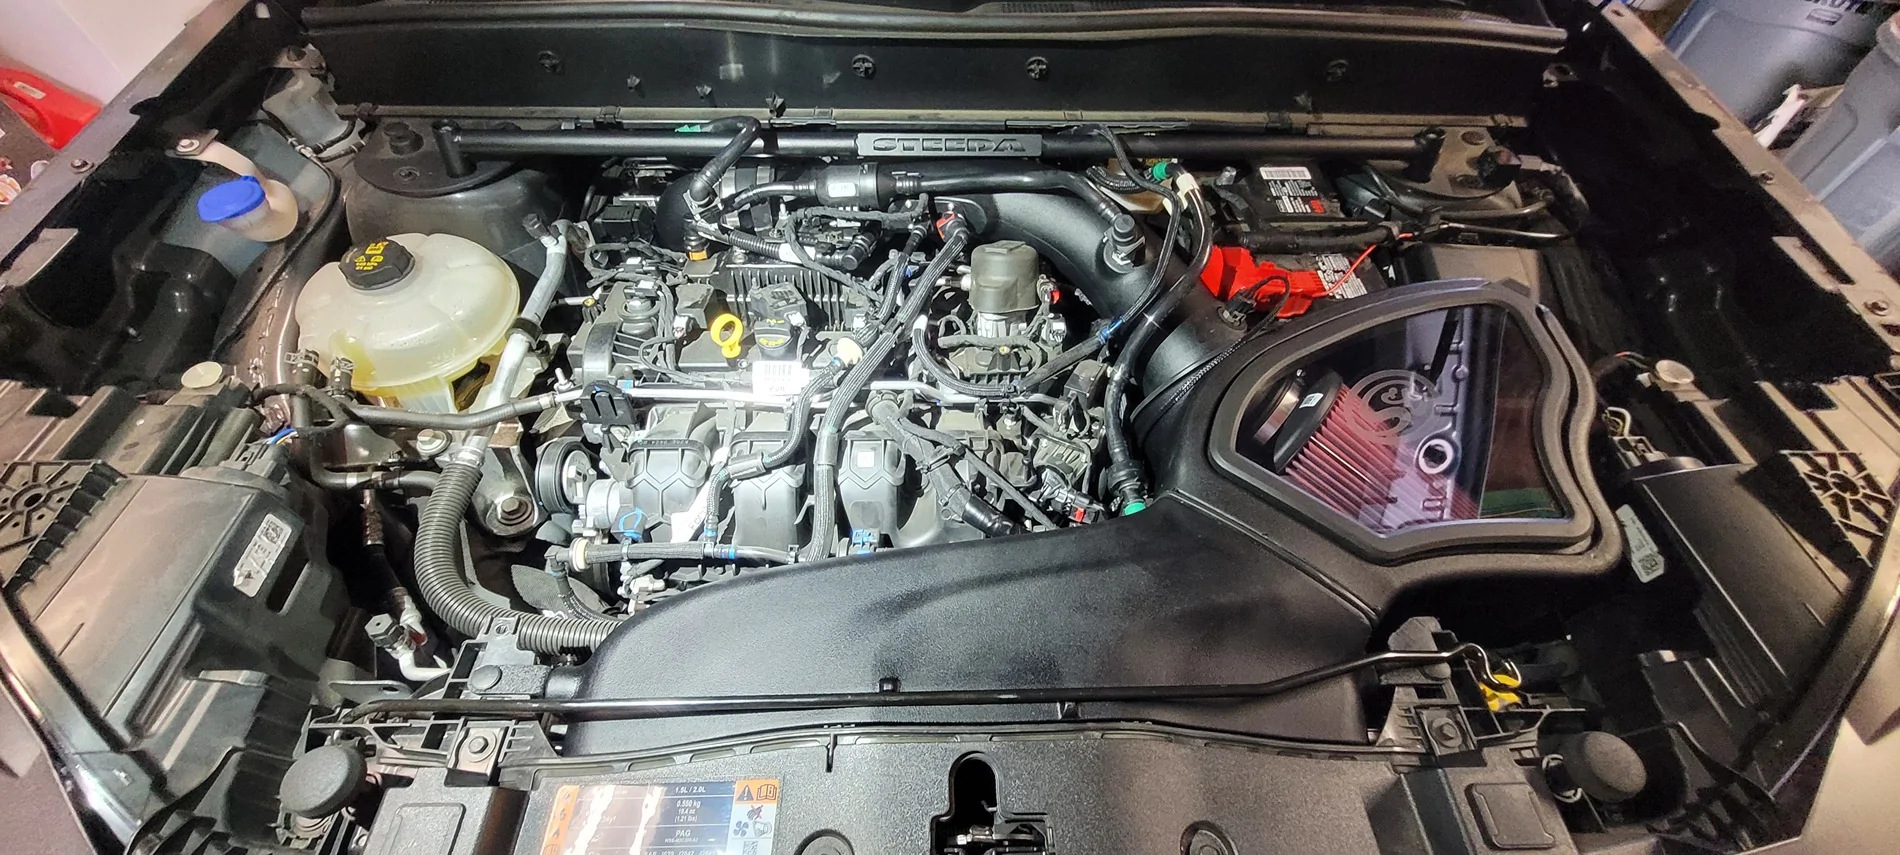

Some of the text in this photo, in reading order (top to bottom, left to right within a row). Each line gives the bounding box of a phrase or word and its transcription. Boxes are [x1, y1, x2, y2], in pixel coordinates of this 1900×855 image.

[873, 138, 1026, 152] STEEDA
[693, 785, 706, 793] 2.0L
[676, 799, 702, 809] 0.550 kg
[675, 829, 691, 837] PAG
